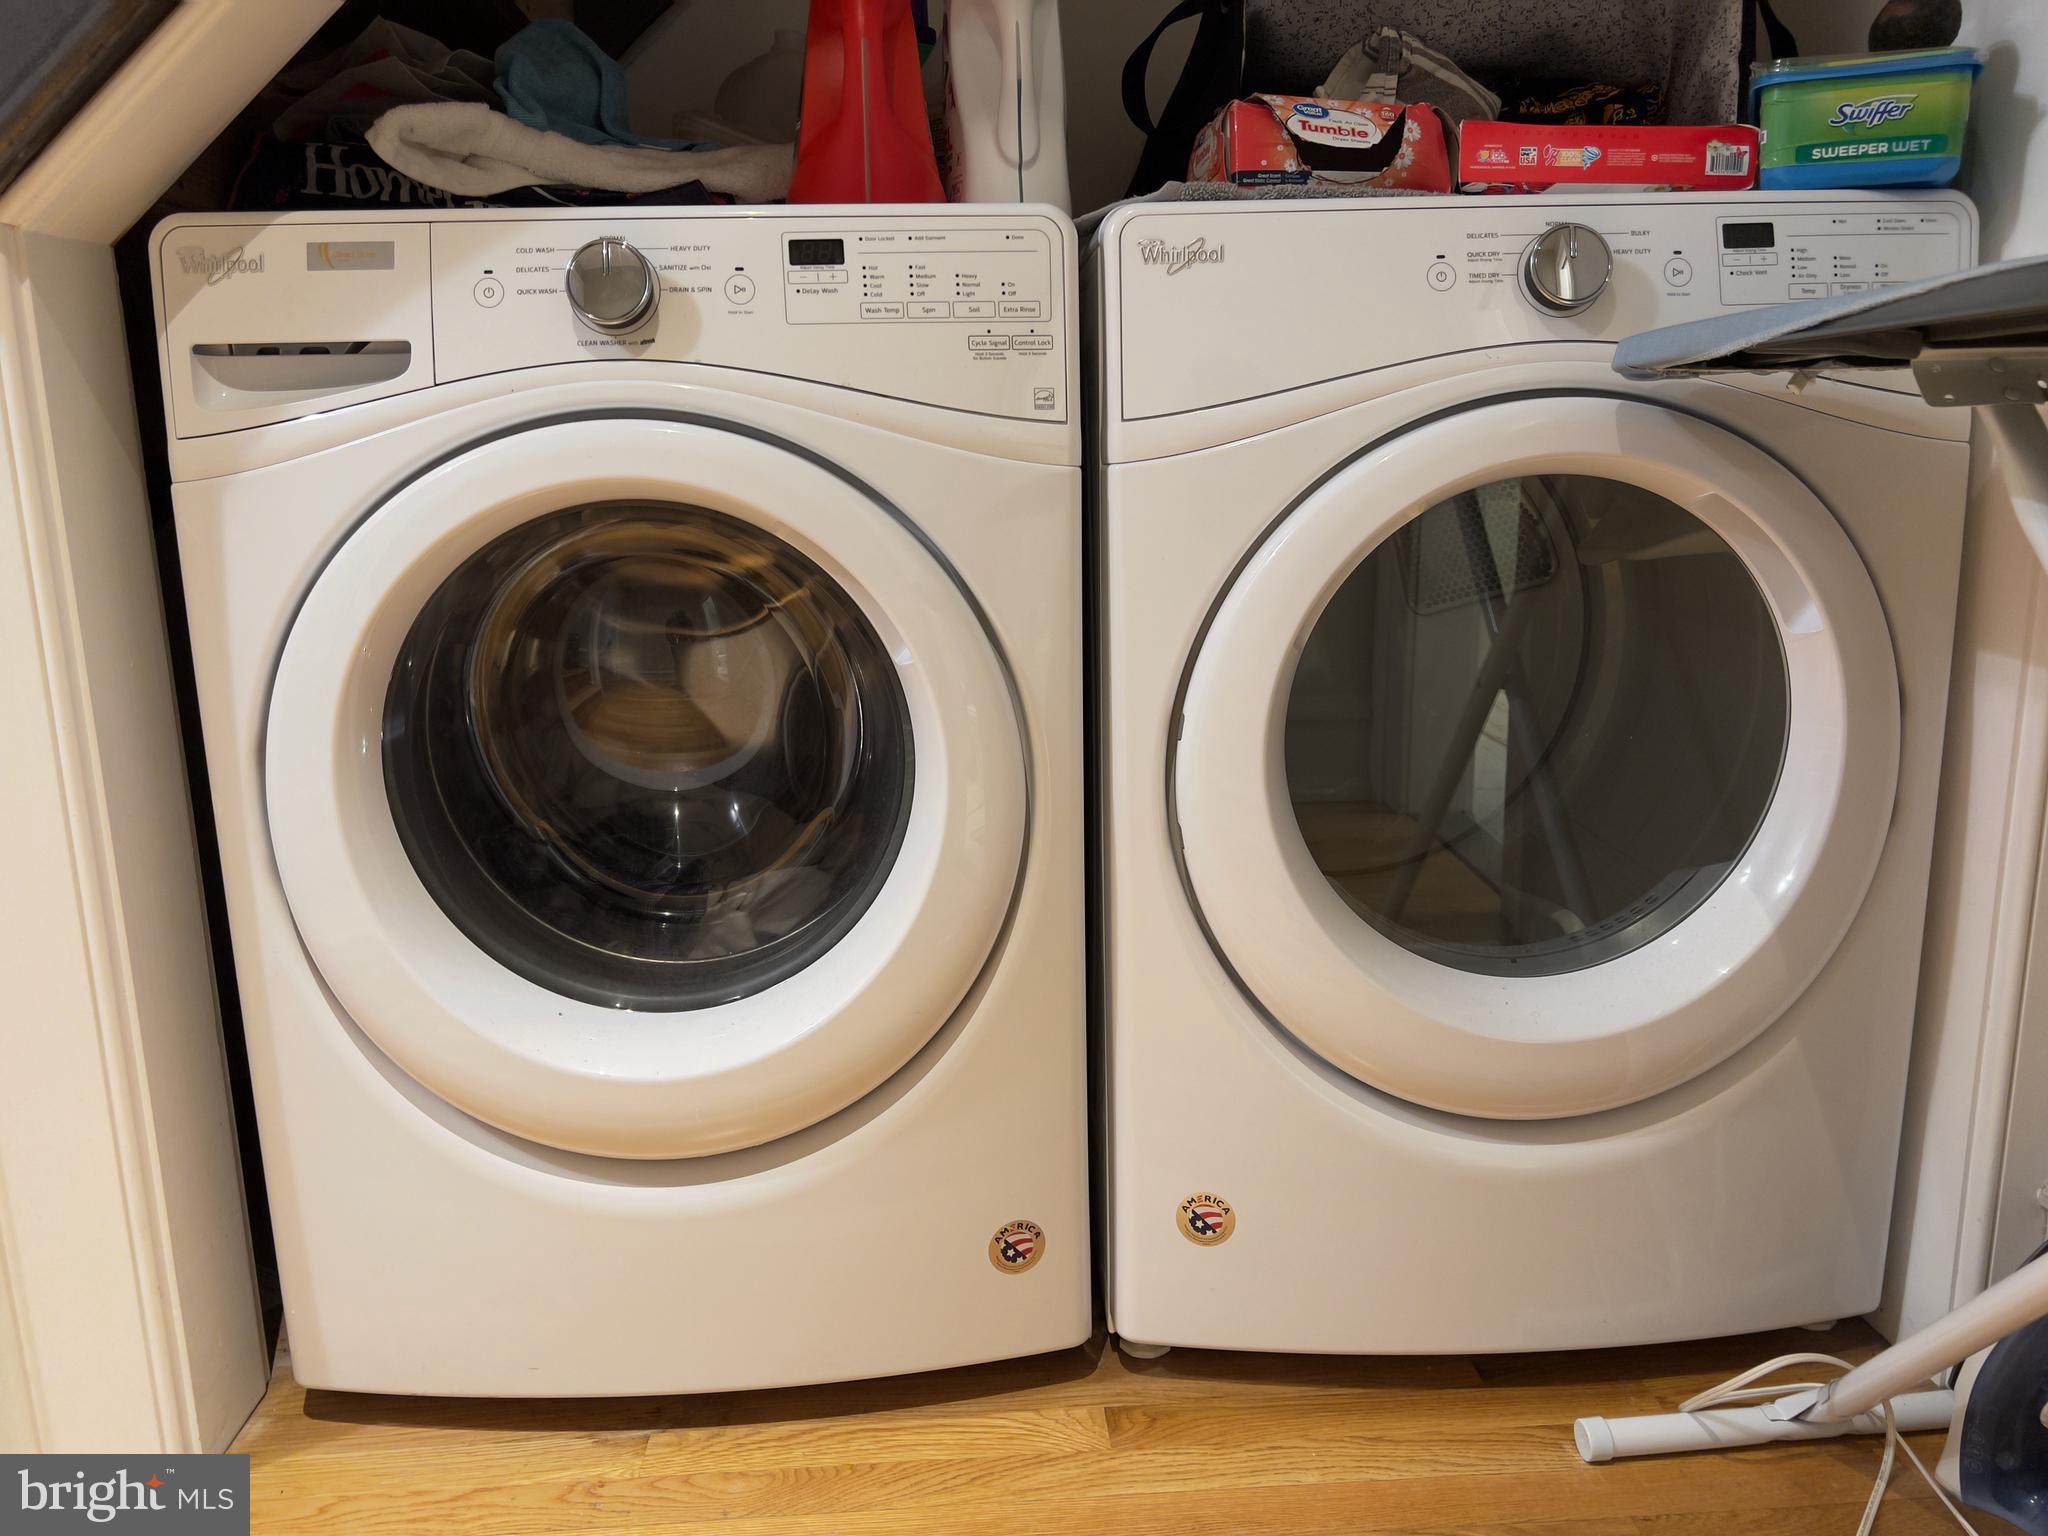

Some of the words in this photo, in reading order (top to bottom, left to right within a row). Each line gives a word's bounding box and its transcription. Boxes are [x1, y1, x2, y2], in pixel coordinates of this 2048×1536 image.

[1297, 104, 1322, 114] Great
[1829, 100, 1913, 128] Swiffer
[1298, 119, 1369, 139] Tumble
[1812, 143, 1889, 160] SWEEPER
[1892, 139, 1932, 153] WET
[1521, 156, 1536, 165] USA
[177, 248, 265, 283] Whirlpool
[1139, 240, 1225, 272] Whirlpool
[801, 288, 820, 296] Delay
[883, 307, 900, 315] Temp
[921, 306, 936, 314] Spin
[971, 339, 987, 347] Cycle
[988, 339, 1008, 347] Signal
[1181, 1194, 1231, 1215] AMERICA
[994, 1222, 1041, 1244] AMERICA
